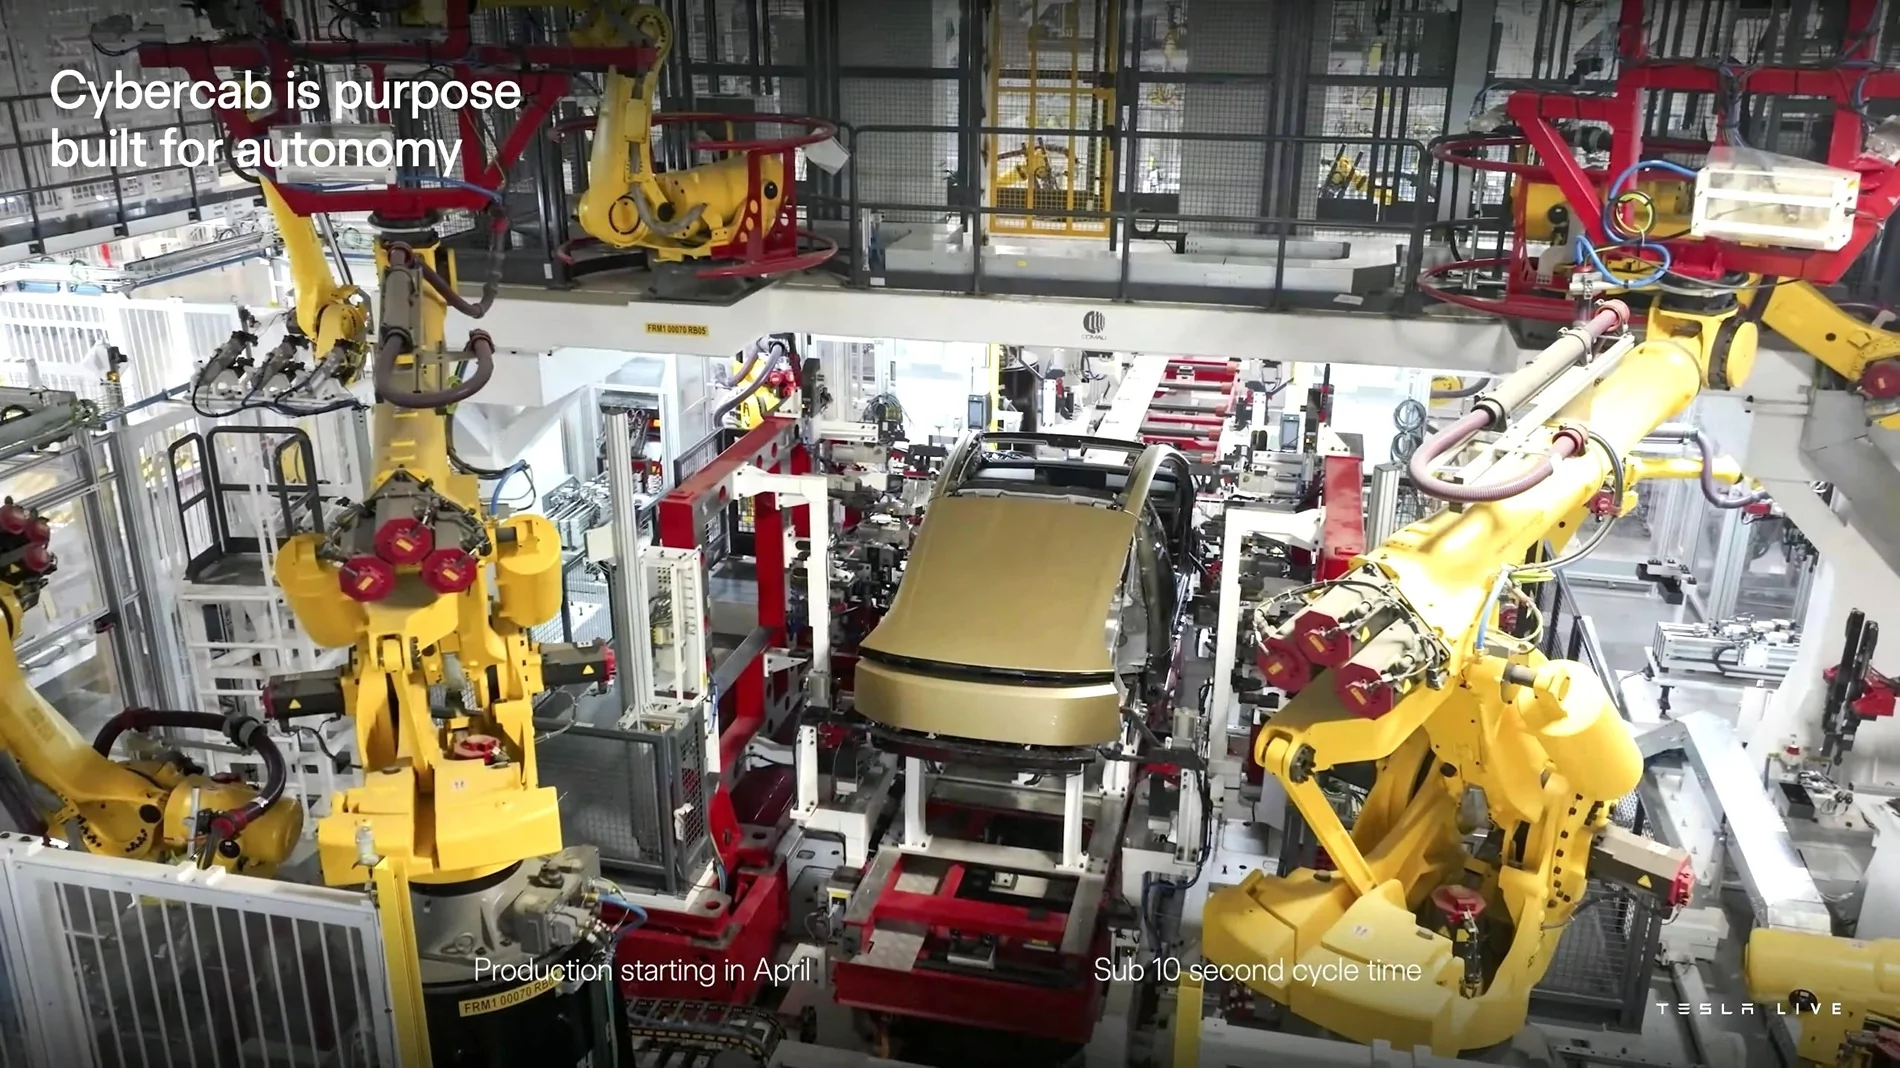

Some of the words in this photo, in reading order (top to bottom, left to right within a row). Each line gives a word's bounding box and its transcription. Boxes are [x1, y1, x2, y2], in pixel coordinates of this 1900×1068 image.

[647, 323, 666, 333] FRM1
[667, 324, 687, 334] 00070
[687, 325, 706, 335] RB05
[464, 998, 497, 1014] FRM1
[500, 987, 532, 1006] 00070
